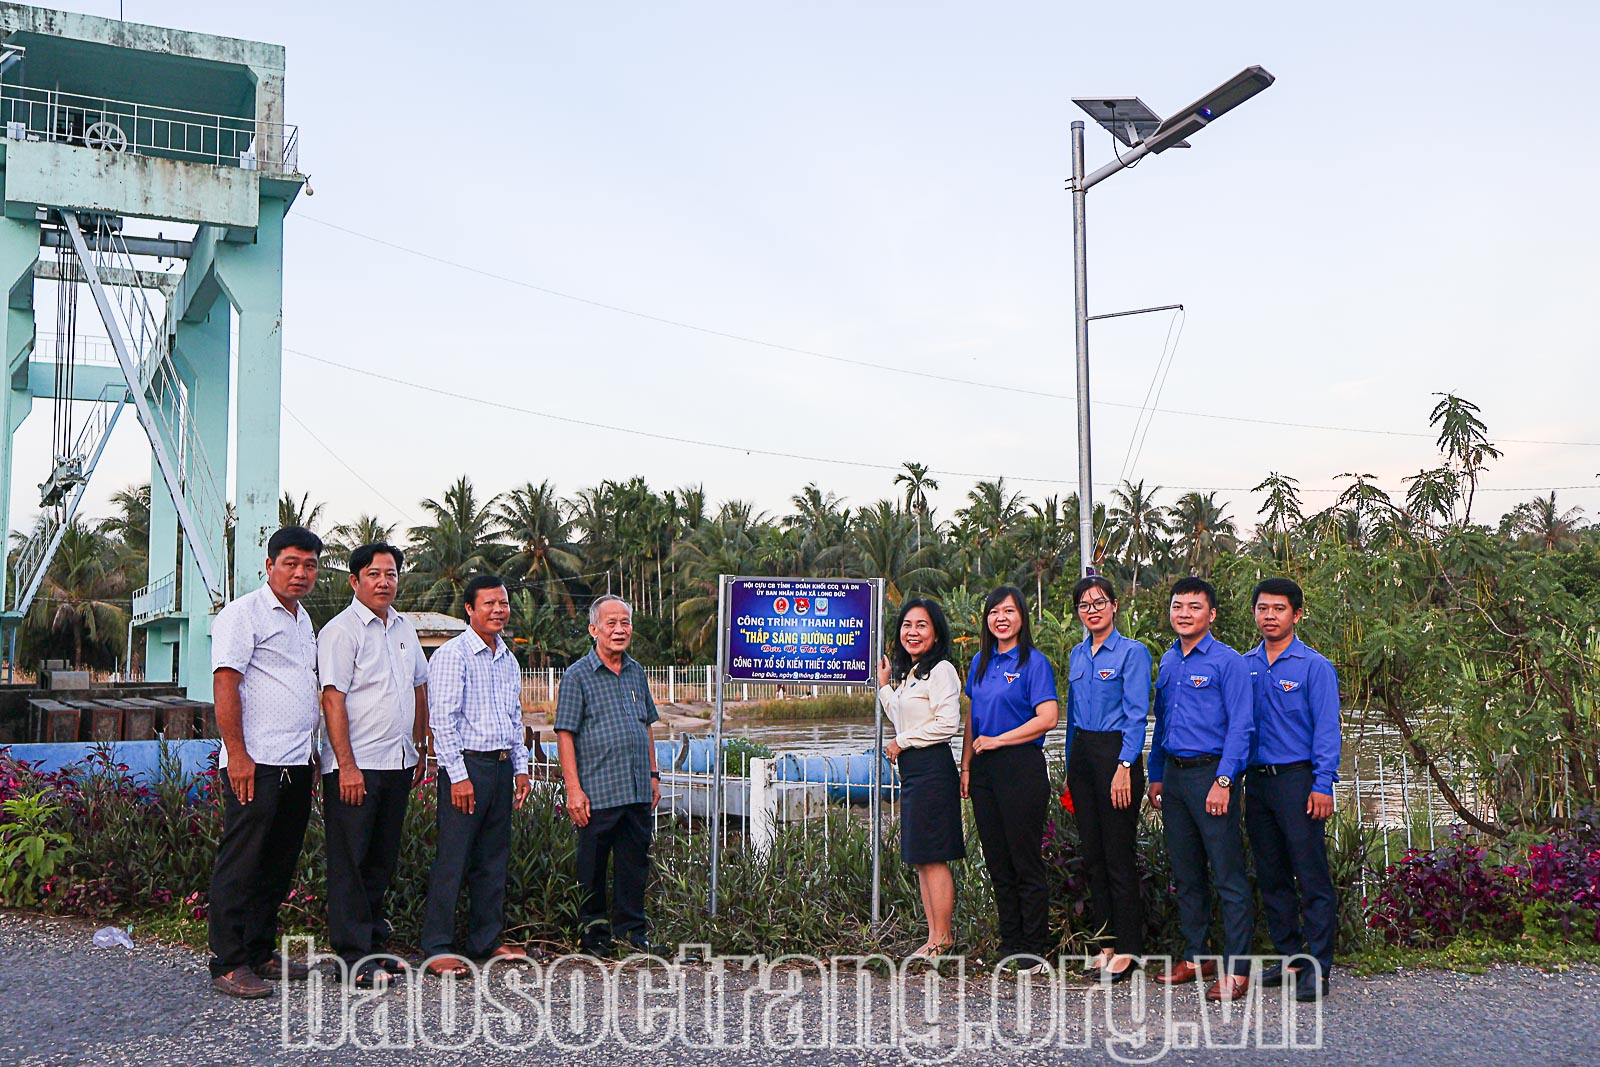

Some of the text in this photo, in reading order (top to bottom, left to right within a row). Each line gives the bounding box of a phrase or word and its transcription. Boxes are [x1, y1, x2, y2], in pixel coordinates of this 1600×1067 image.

[812, 582, 826, 590] KHỐI
[796, 589, 808, 597] DÂN
[737, 616, 863, 628] CÔNG TRÌNH THANH NIÊN
[772, 631, 798, 644] SÁNG
[800, 630, 834, 645] ĐƯỜNG
[733, 656, 751, 668] CÔNG
[754, 658, 762, 668] TY
[764, 655, 775, 669] XỔ
[776, 656, 786, 669] SỐ
[787, 656, 803, 669] KIẾN
[805, 657, 825, 670] THIẾT
[827, 658, 841, 670] SÓC
[799, 672, 815, 680] tháng
